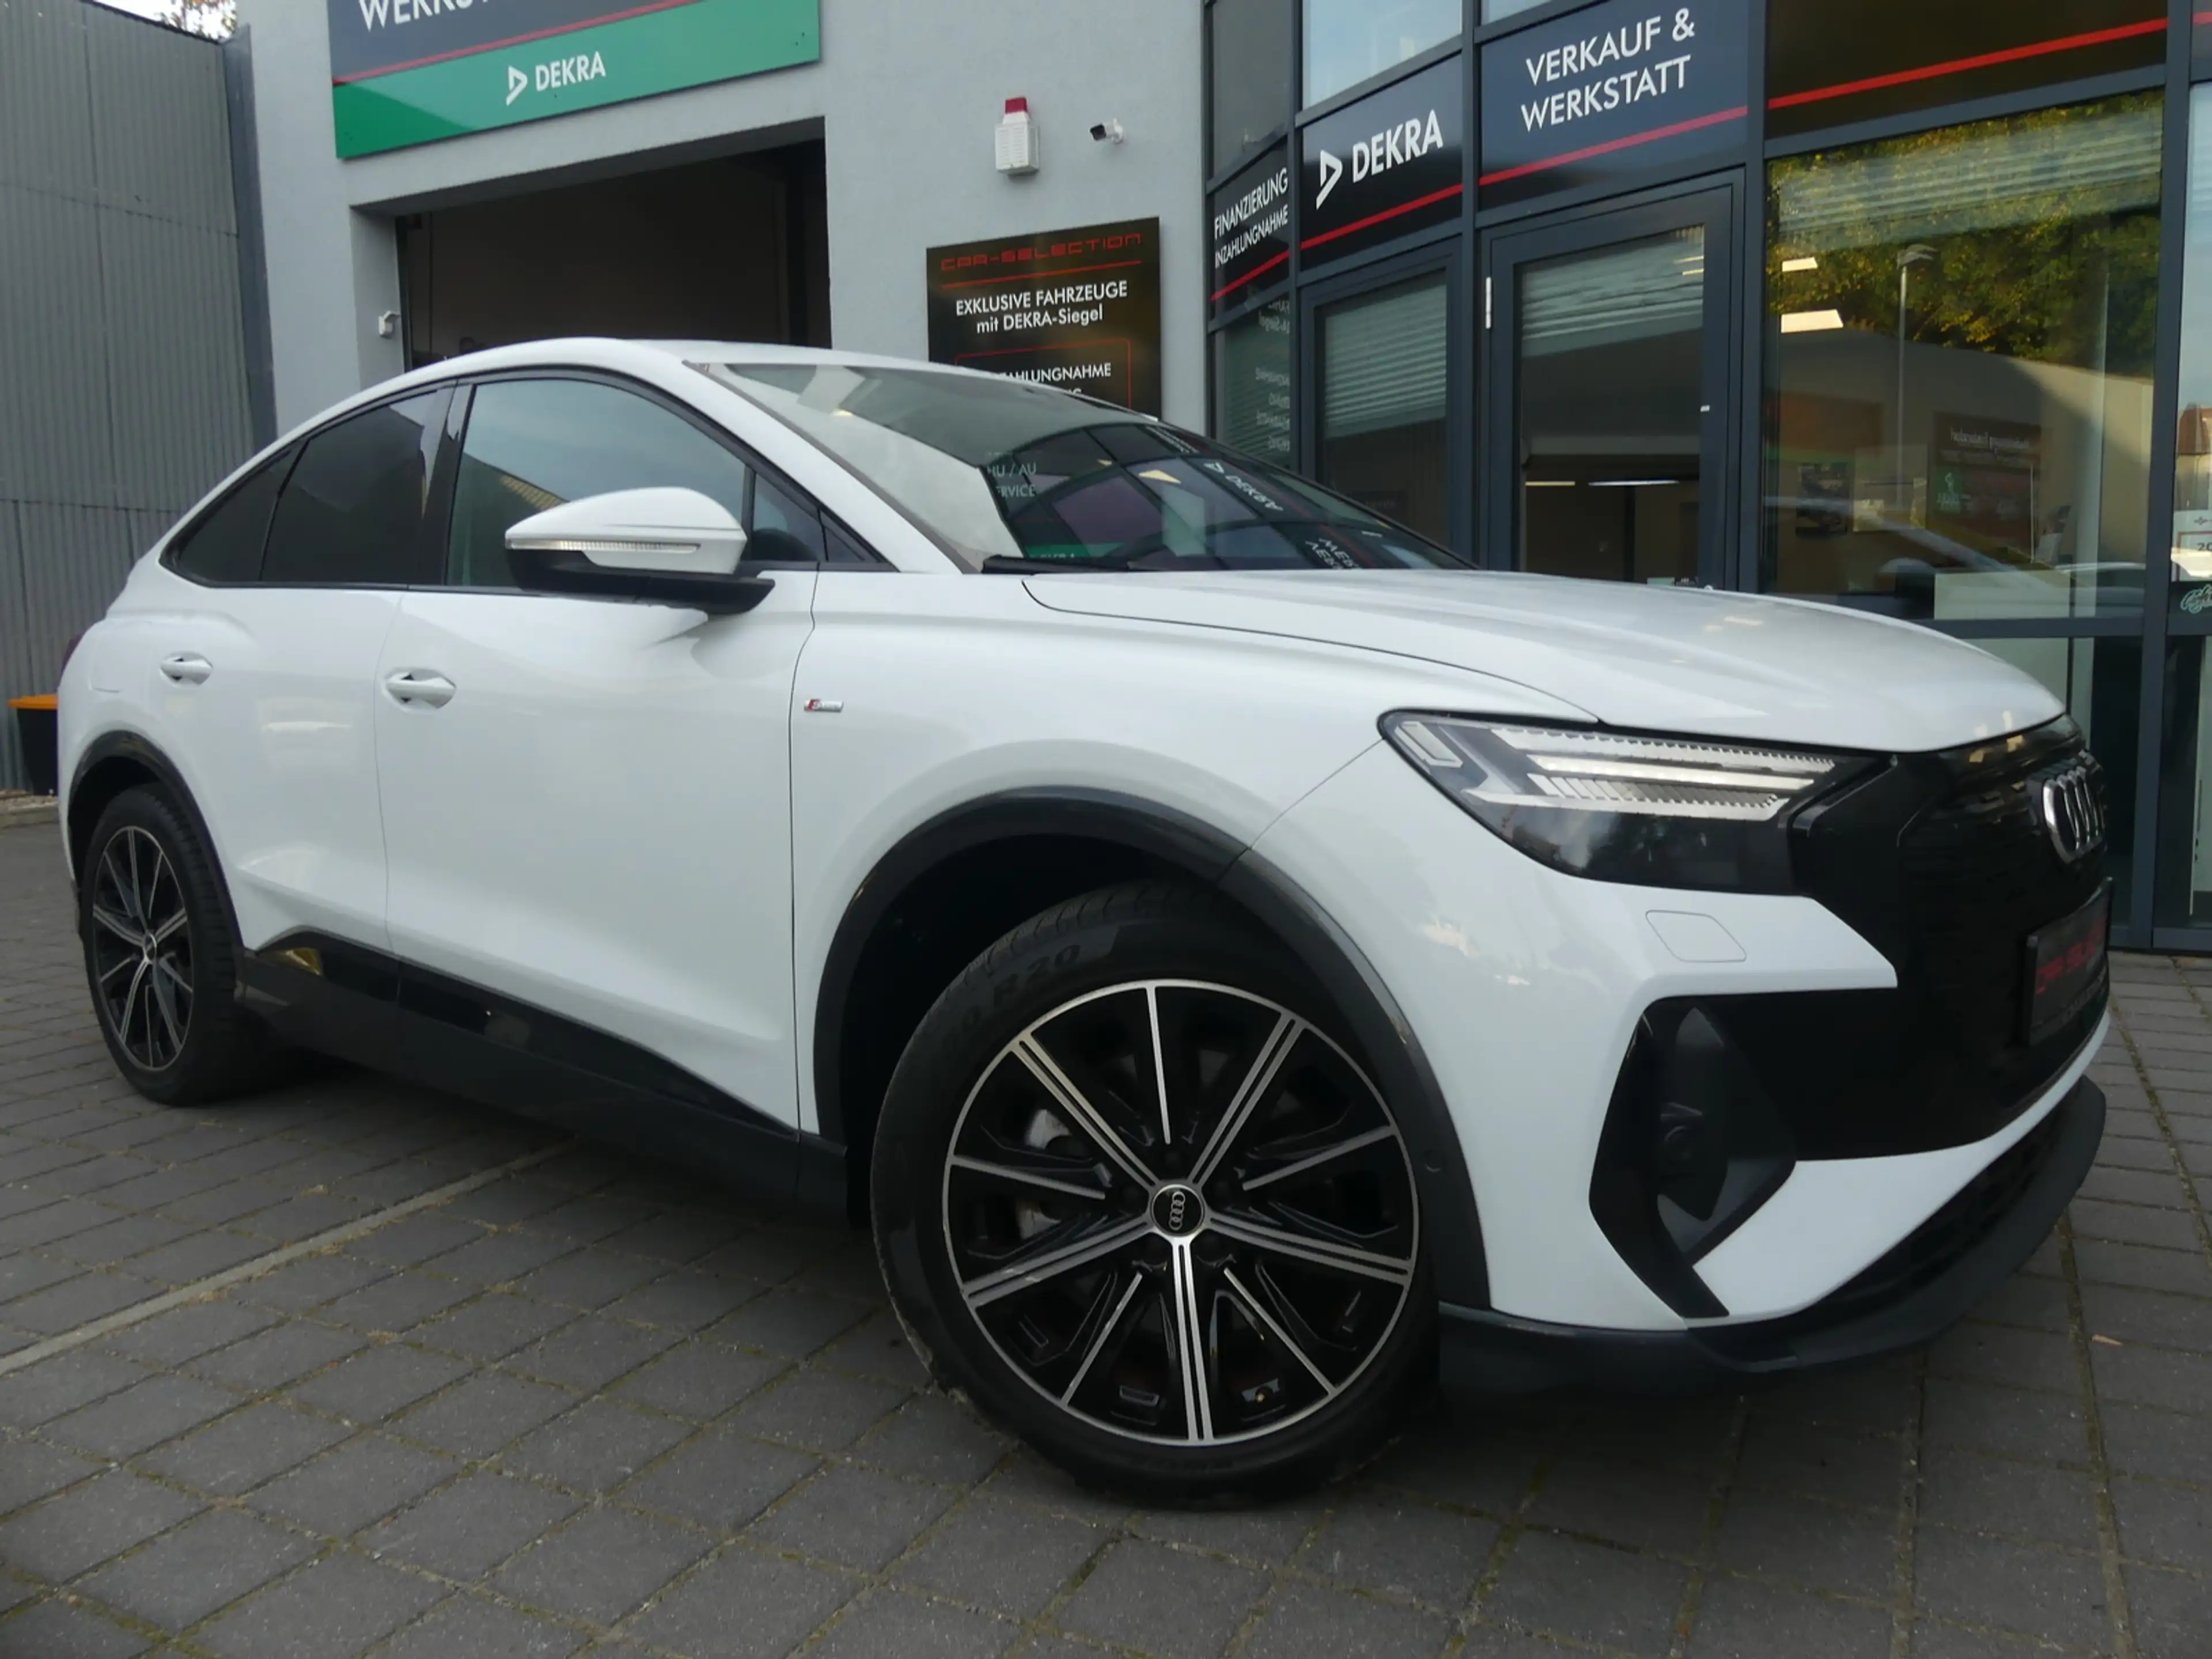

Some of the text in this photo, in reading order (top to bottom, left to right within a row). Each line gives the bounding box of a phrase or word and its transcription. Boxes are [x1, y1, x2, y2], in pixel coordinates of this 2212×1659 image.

[535, 51, 606, 92] DEKRA
[1526, 7, 1695, 86] VERKAUF &
[1521, 54, 1691, 132] WERKSTATT
[1353, 108, 1443, 184] DEKRA
[1215, 167, 1288, 240] FINANZIERUNG
[956, 280, 1128, 316] EXKLUSIVE FAHRZEUGE
[977, 303, 1103, 334] mit DEKRA-Siegel
